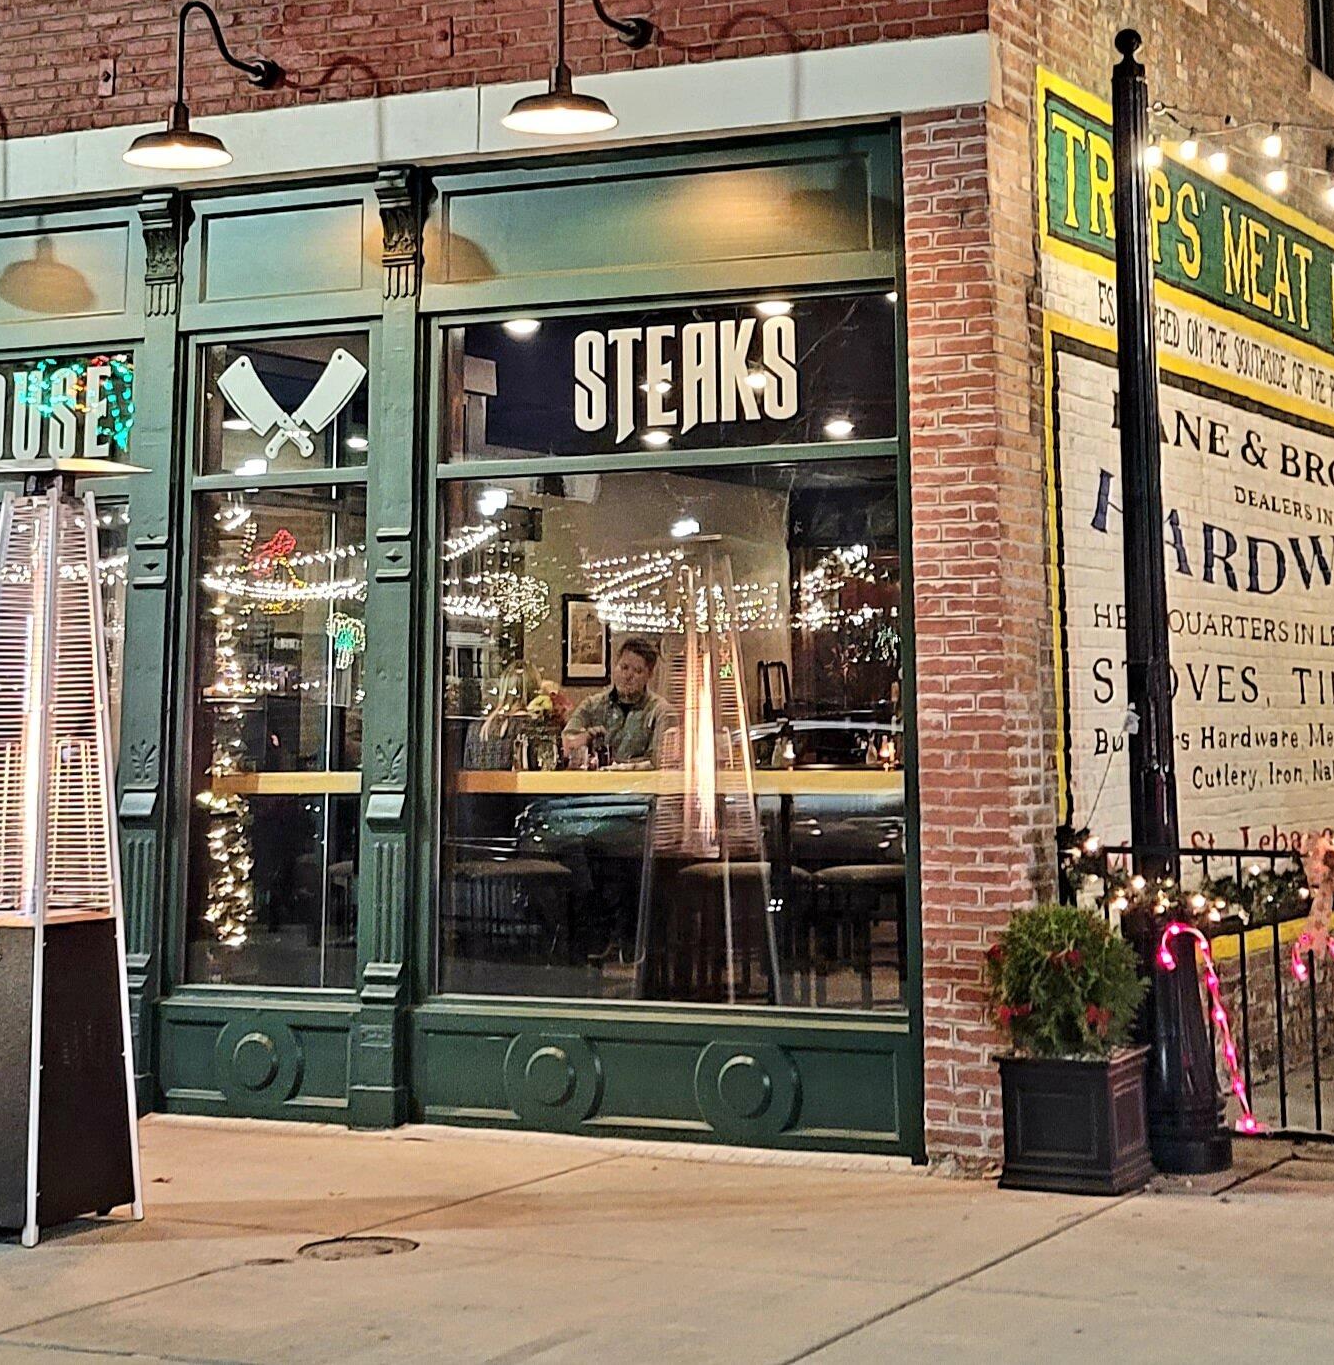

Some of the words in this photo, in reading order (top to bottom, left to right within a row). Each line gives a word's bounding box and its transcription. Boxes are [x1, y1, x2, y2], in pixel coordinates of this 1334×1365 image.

[1051, 111, 1207, 280] TRPS'
[1222, 205, 1313, 331] MEAT
[574, 315, 799, 445] STEAKS
[1187, 317, 1204, 359] ON
[1208, 325, 1229, 369] THE
[1234, 335, 1288, 390] SOUTHSIDE
[1292, 361, 1304, 396] OF
[1309, 367, 1326, 404] THE
[1240, 429, 1269, 470] &
[1234, 485, 1313, 521] DEALERS
[1317, 507, 1334, 527] IN
[1093, 603, 1289, 643] HEQUARTERS
[1295, 622, 1314, 646] IN
